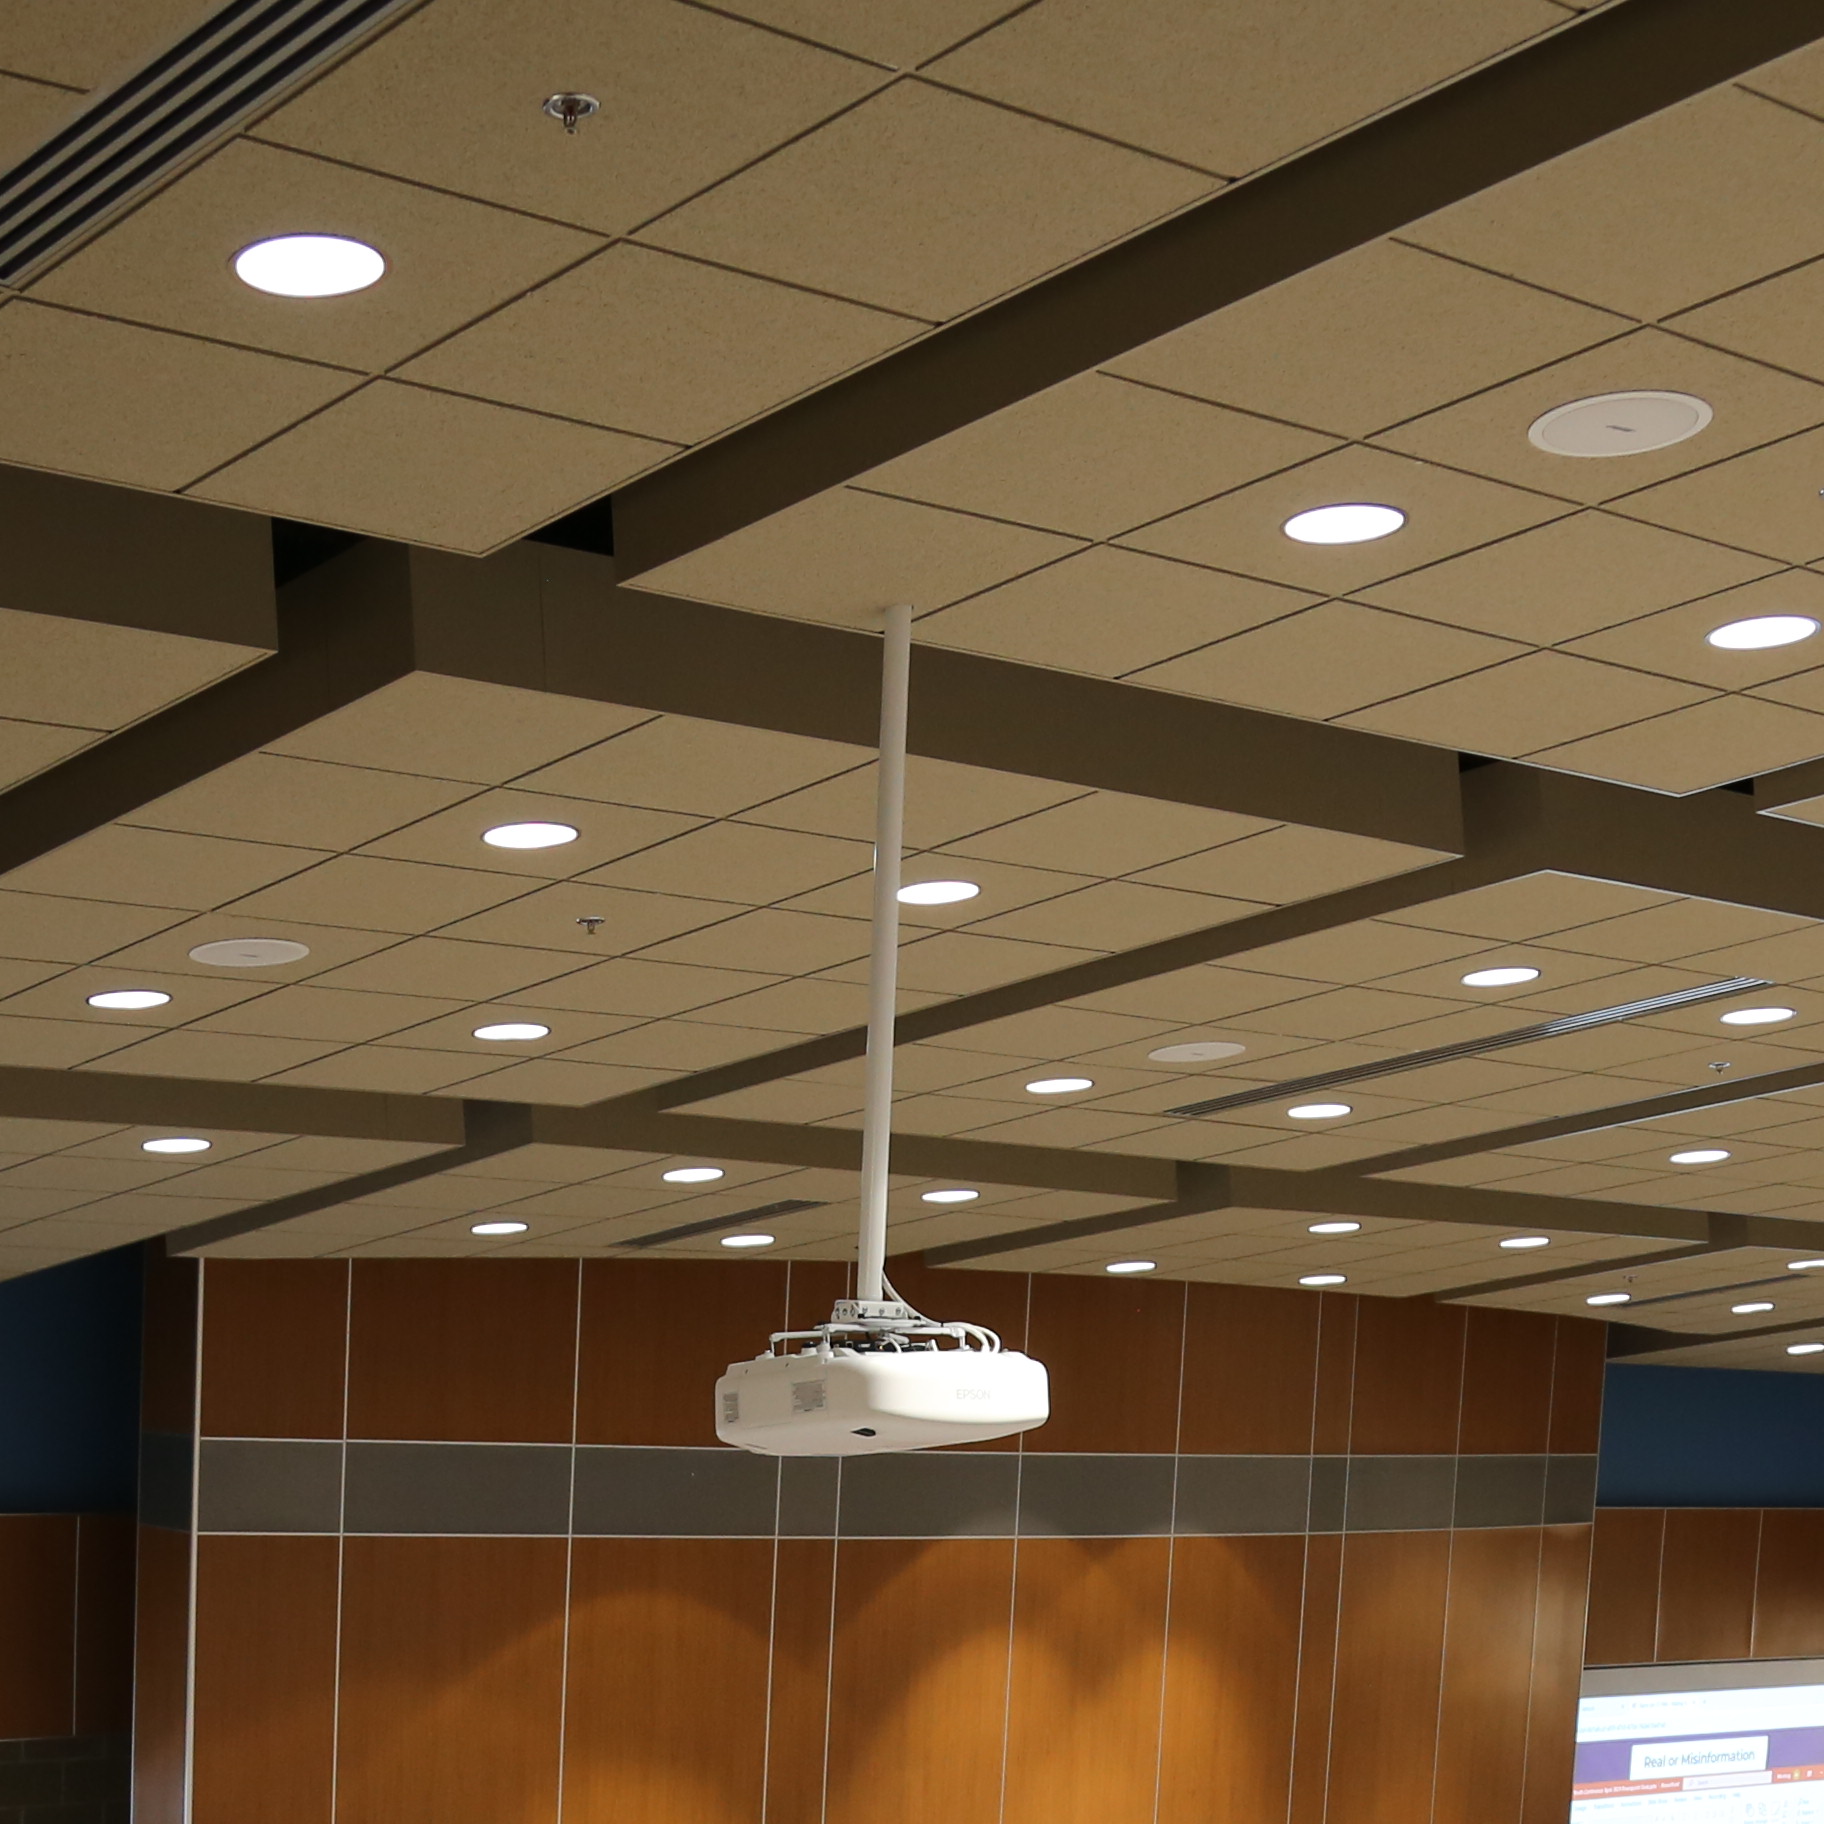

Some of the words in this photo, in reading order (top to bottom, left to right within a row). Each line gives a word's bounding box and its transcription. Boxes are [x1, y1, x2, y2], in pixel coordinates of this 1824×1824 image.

[955, 1388, 991, 1401] EPSON
[1643, 1749, 1666, 1769] Real
[1668, 1752, 1680, 1767] or
[1681, 1746, 1756, 1766] Misinformation
